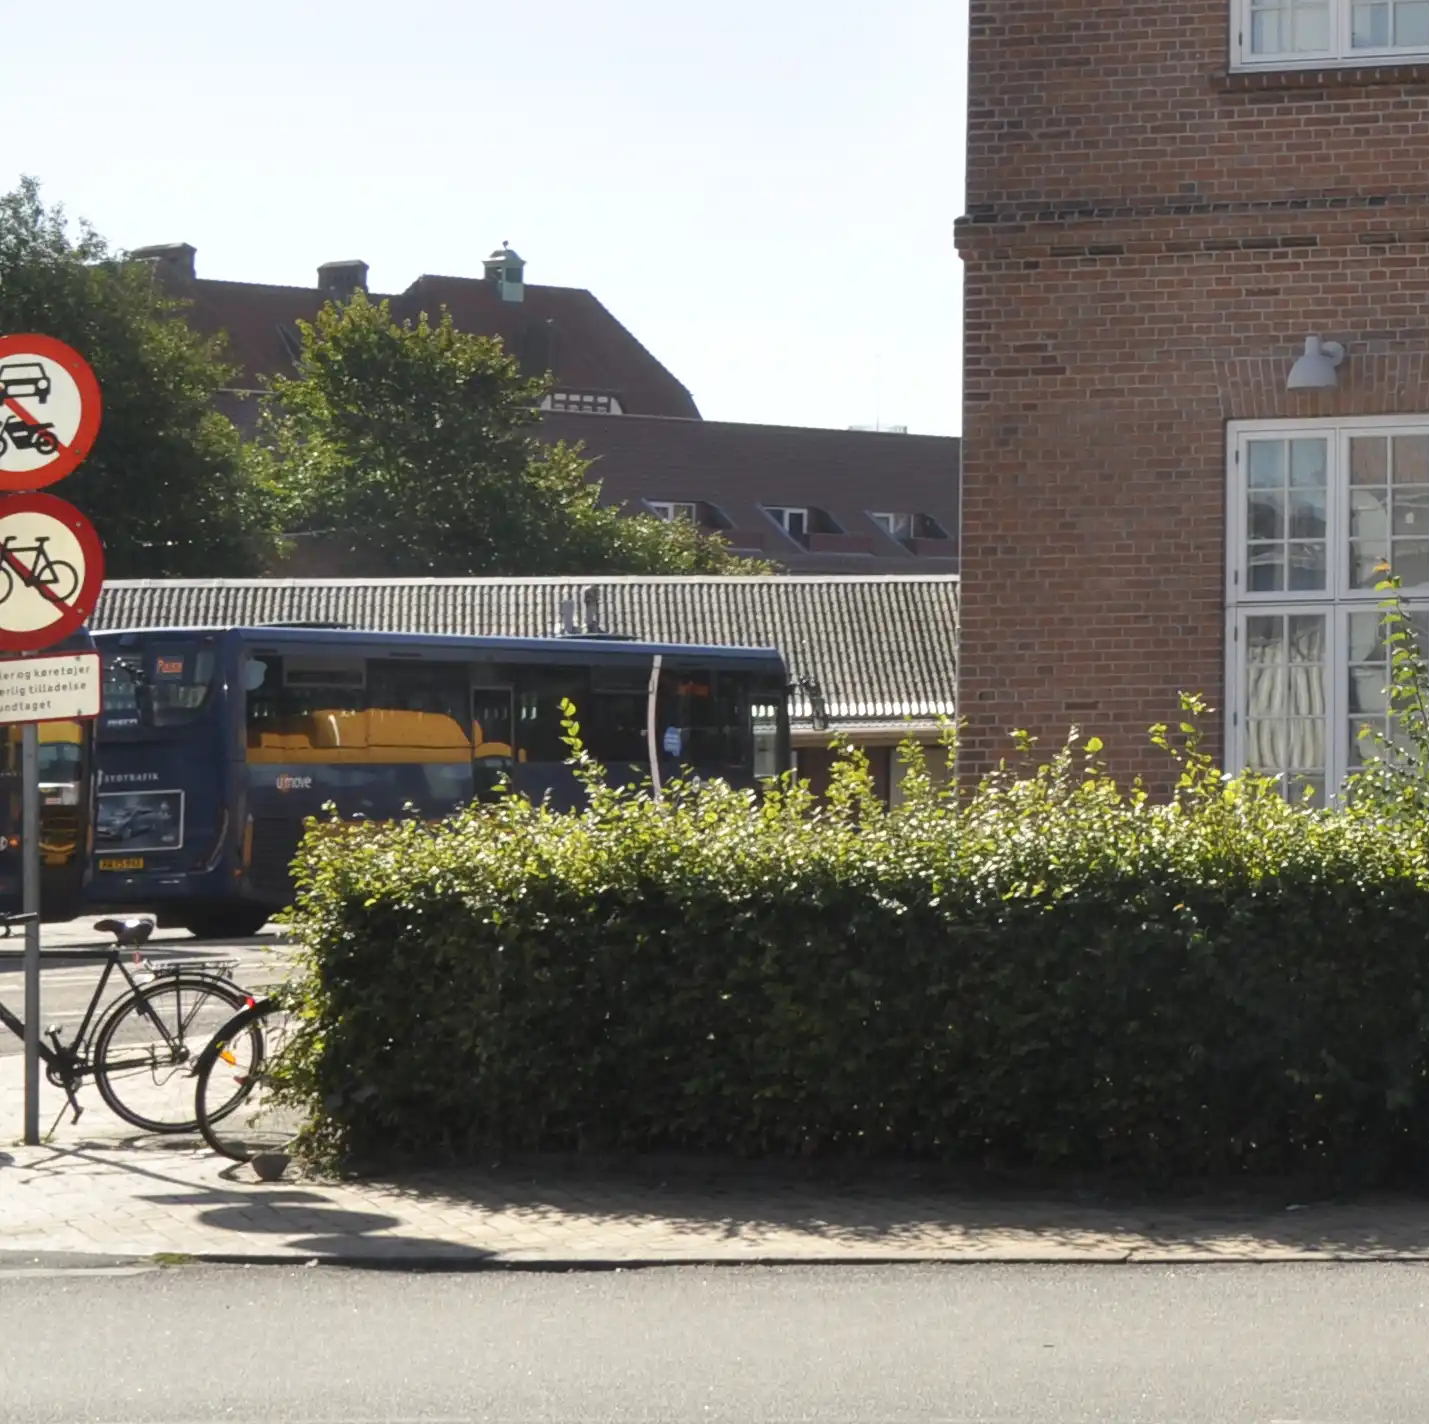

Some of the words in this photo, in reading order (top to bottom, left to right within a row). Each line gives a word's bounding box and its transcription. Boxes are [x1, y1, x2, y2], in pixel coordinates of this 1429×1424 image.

[17, 671, 31, 681] og
[34, 665, 90, 677] køretøjer
[29, 682, 87, 694] tilladelse
